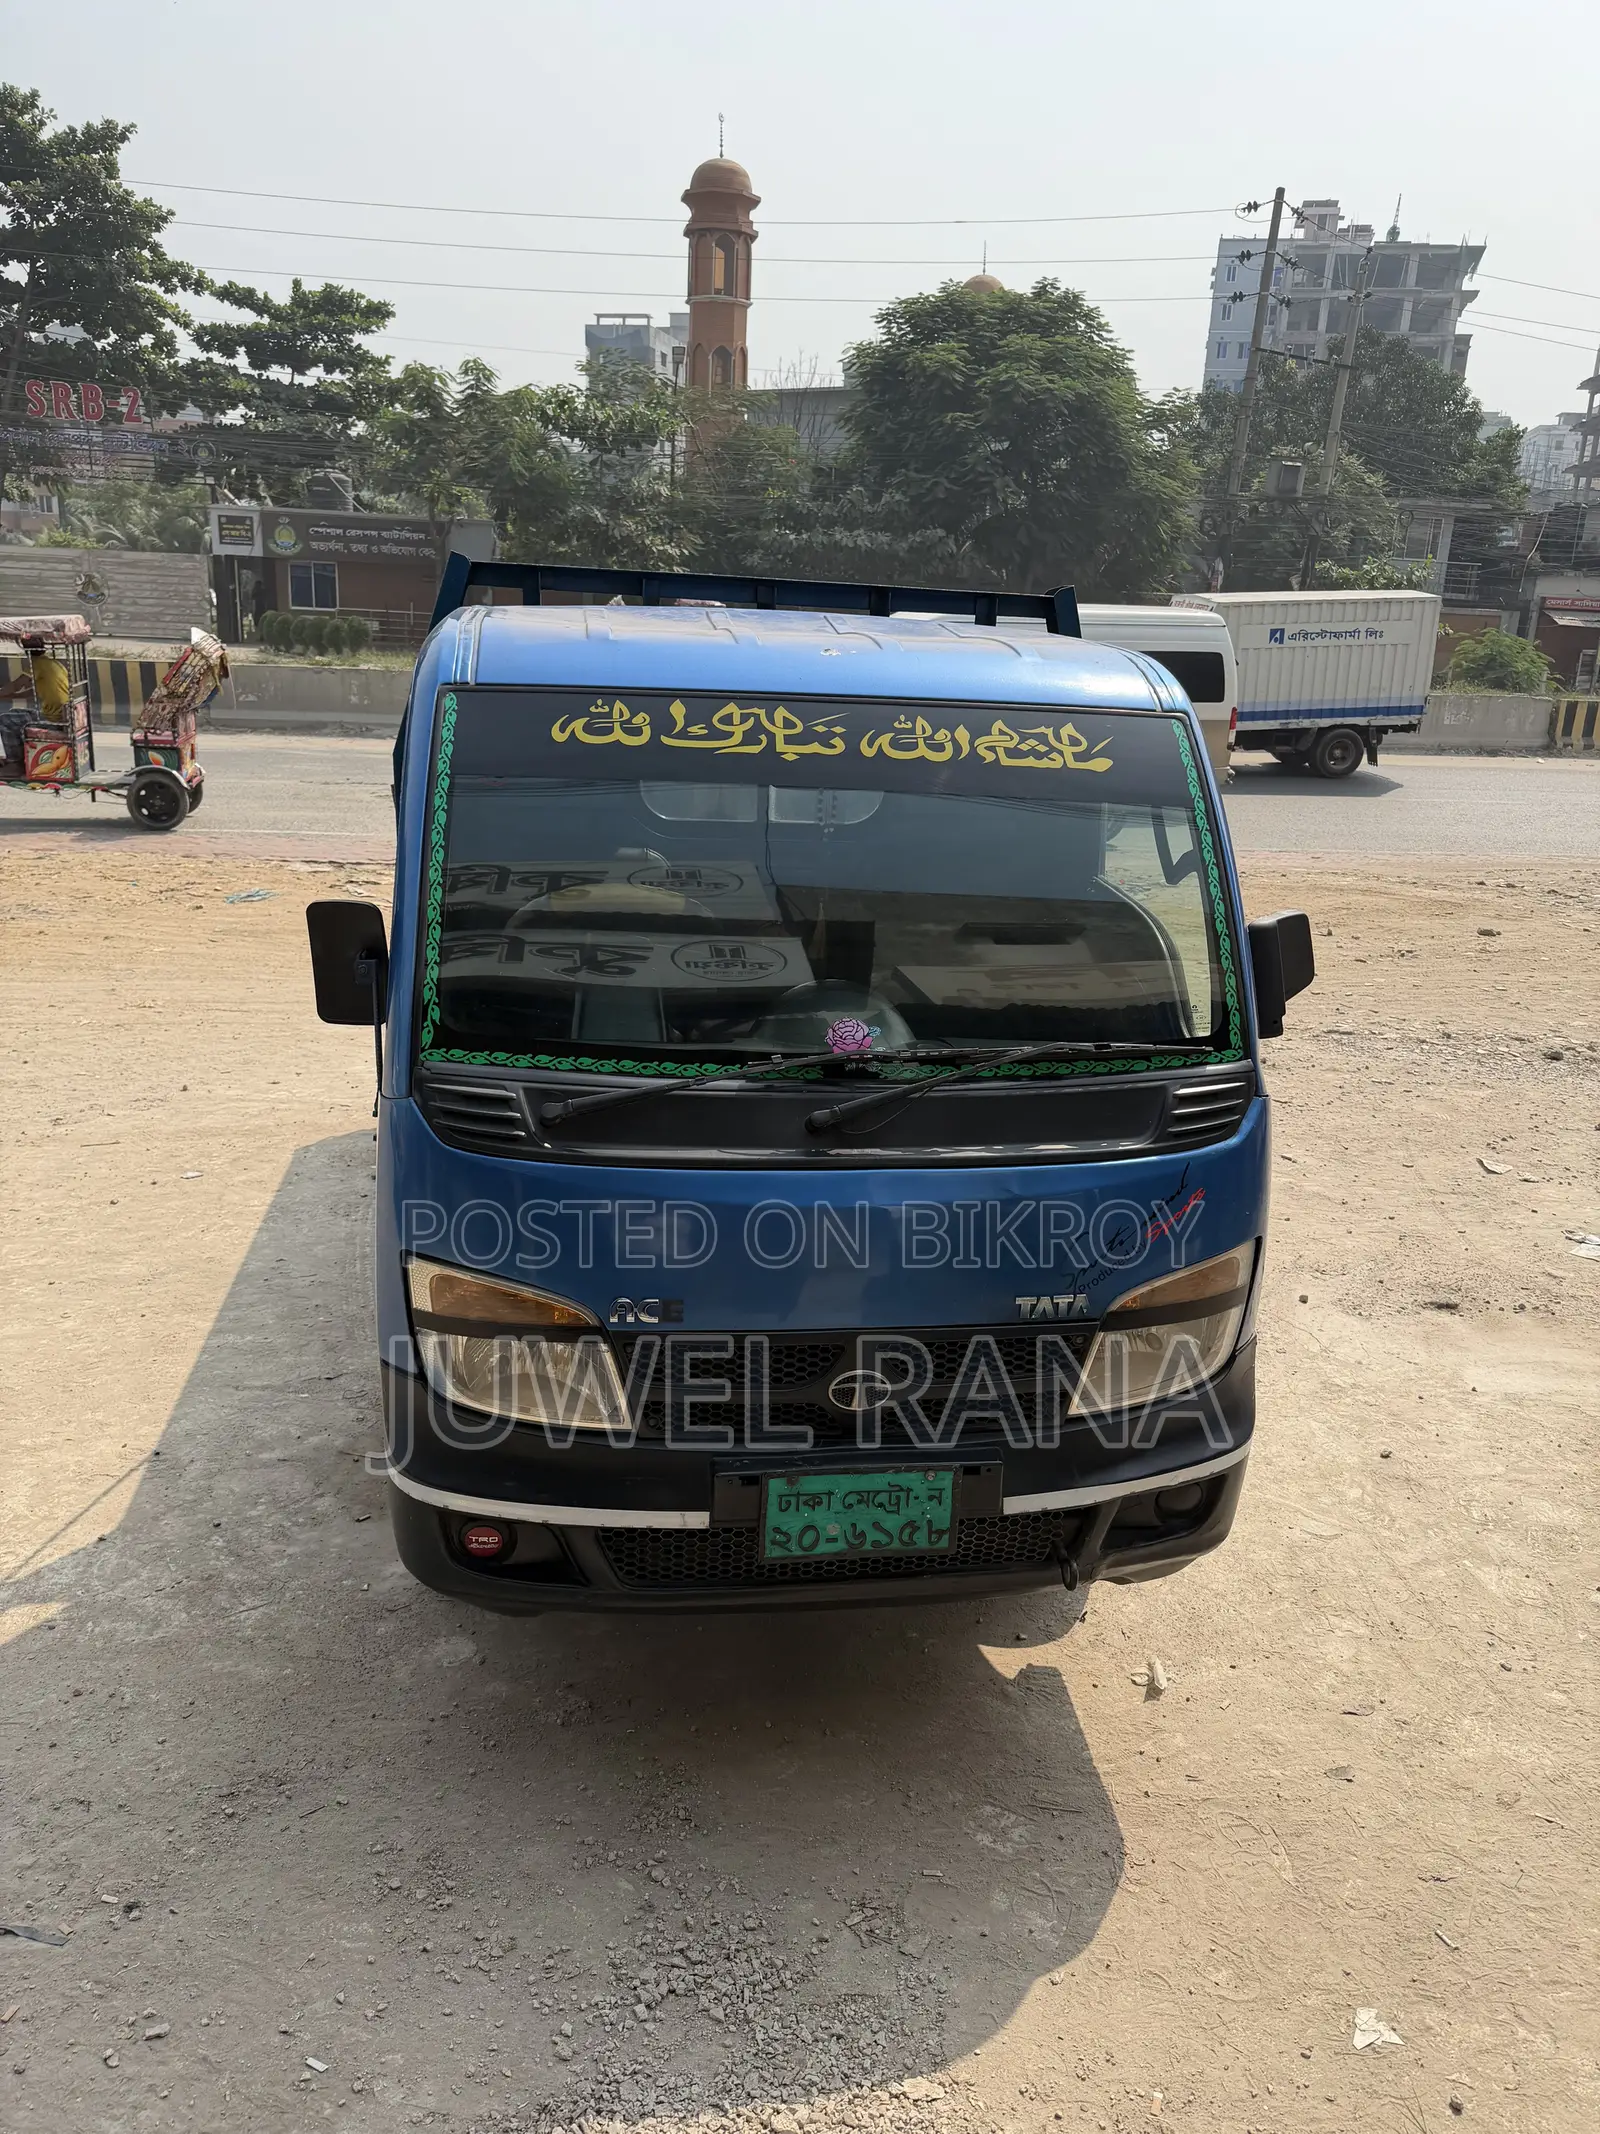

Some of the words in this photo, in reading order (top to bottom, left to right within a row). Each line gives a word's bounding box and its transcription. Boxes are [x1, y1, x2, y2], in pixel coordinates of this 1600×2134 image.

[25, 379, 144, 424] SRB-2
[1287, 628, 1361, 642] এরিস্টোফার্মা
[1078, 1250, 1133, 1294] Produced
[609, 1297, 684, 1323] ACE
[1015, 1293, 1090, 1320] TATA
[777, 1490, 834, 1513] ঢাকা
